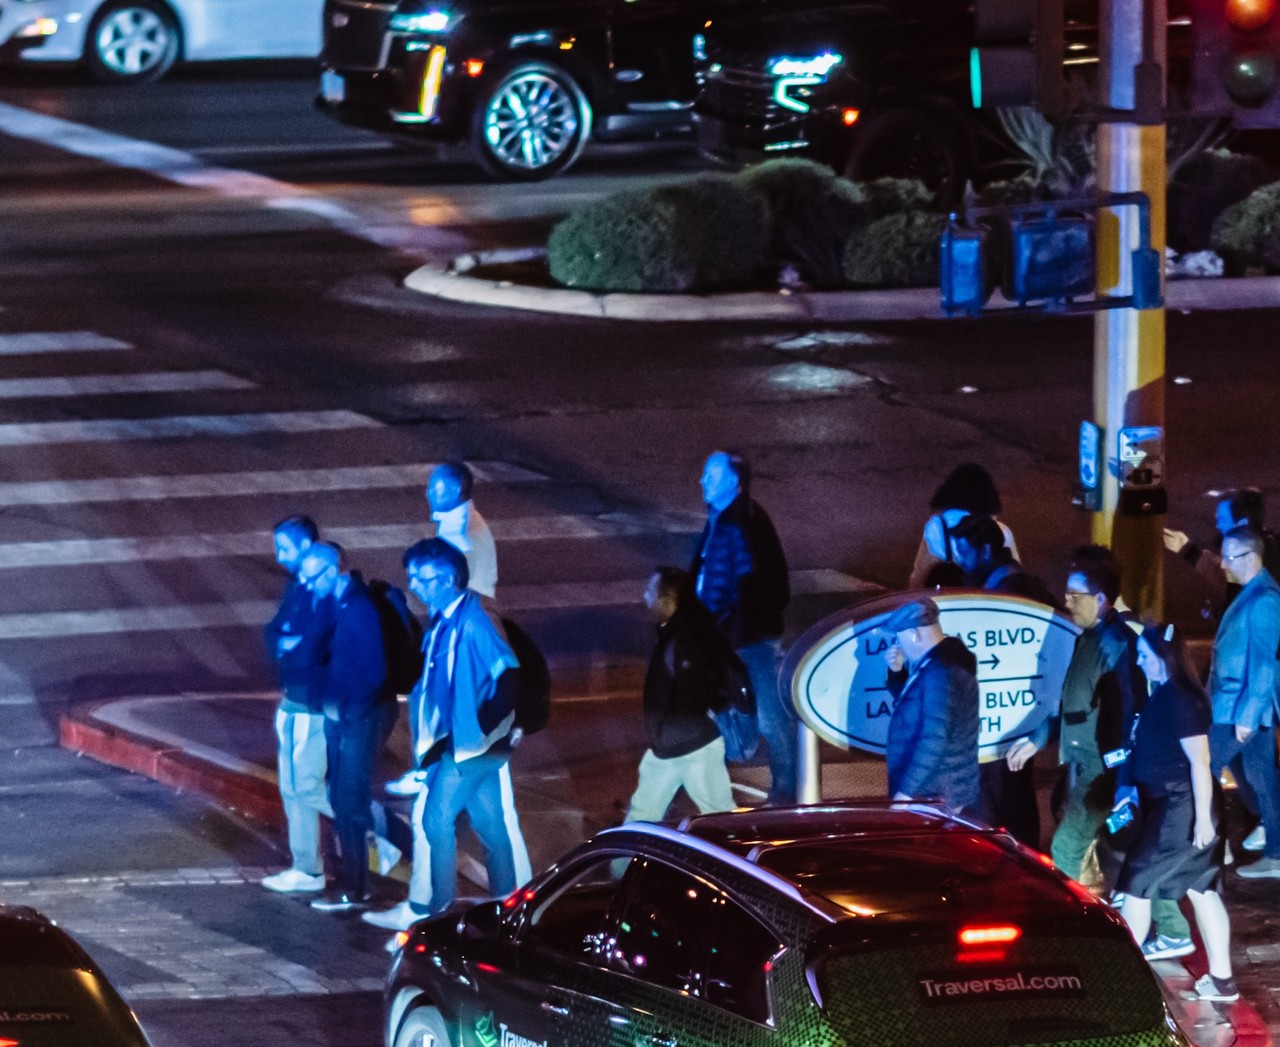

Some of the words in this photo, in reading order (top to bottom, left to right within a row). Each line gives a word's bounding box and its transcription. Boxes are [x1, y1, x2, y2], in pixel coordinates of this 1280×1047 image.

[985, 627, 1041, 647] BLVD.
[986, 689, 1042, 709] BLVD.
[920, 973, 1081, 998] Traversal.com
